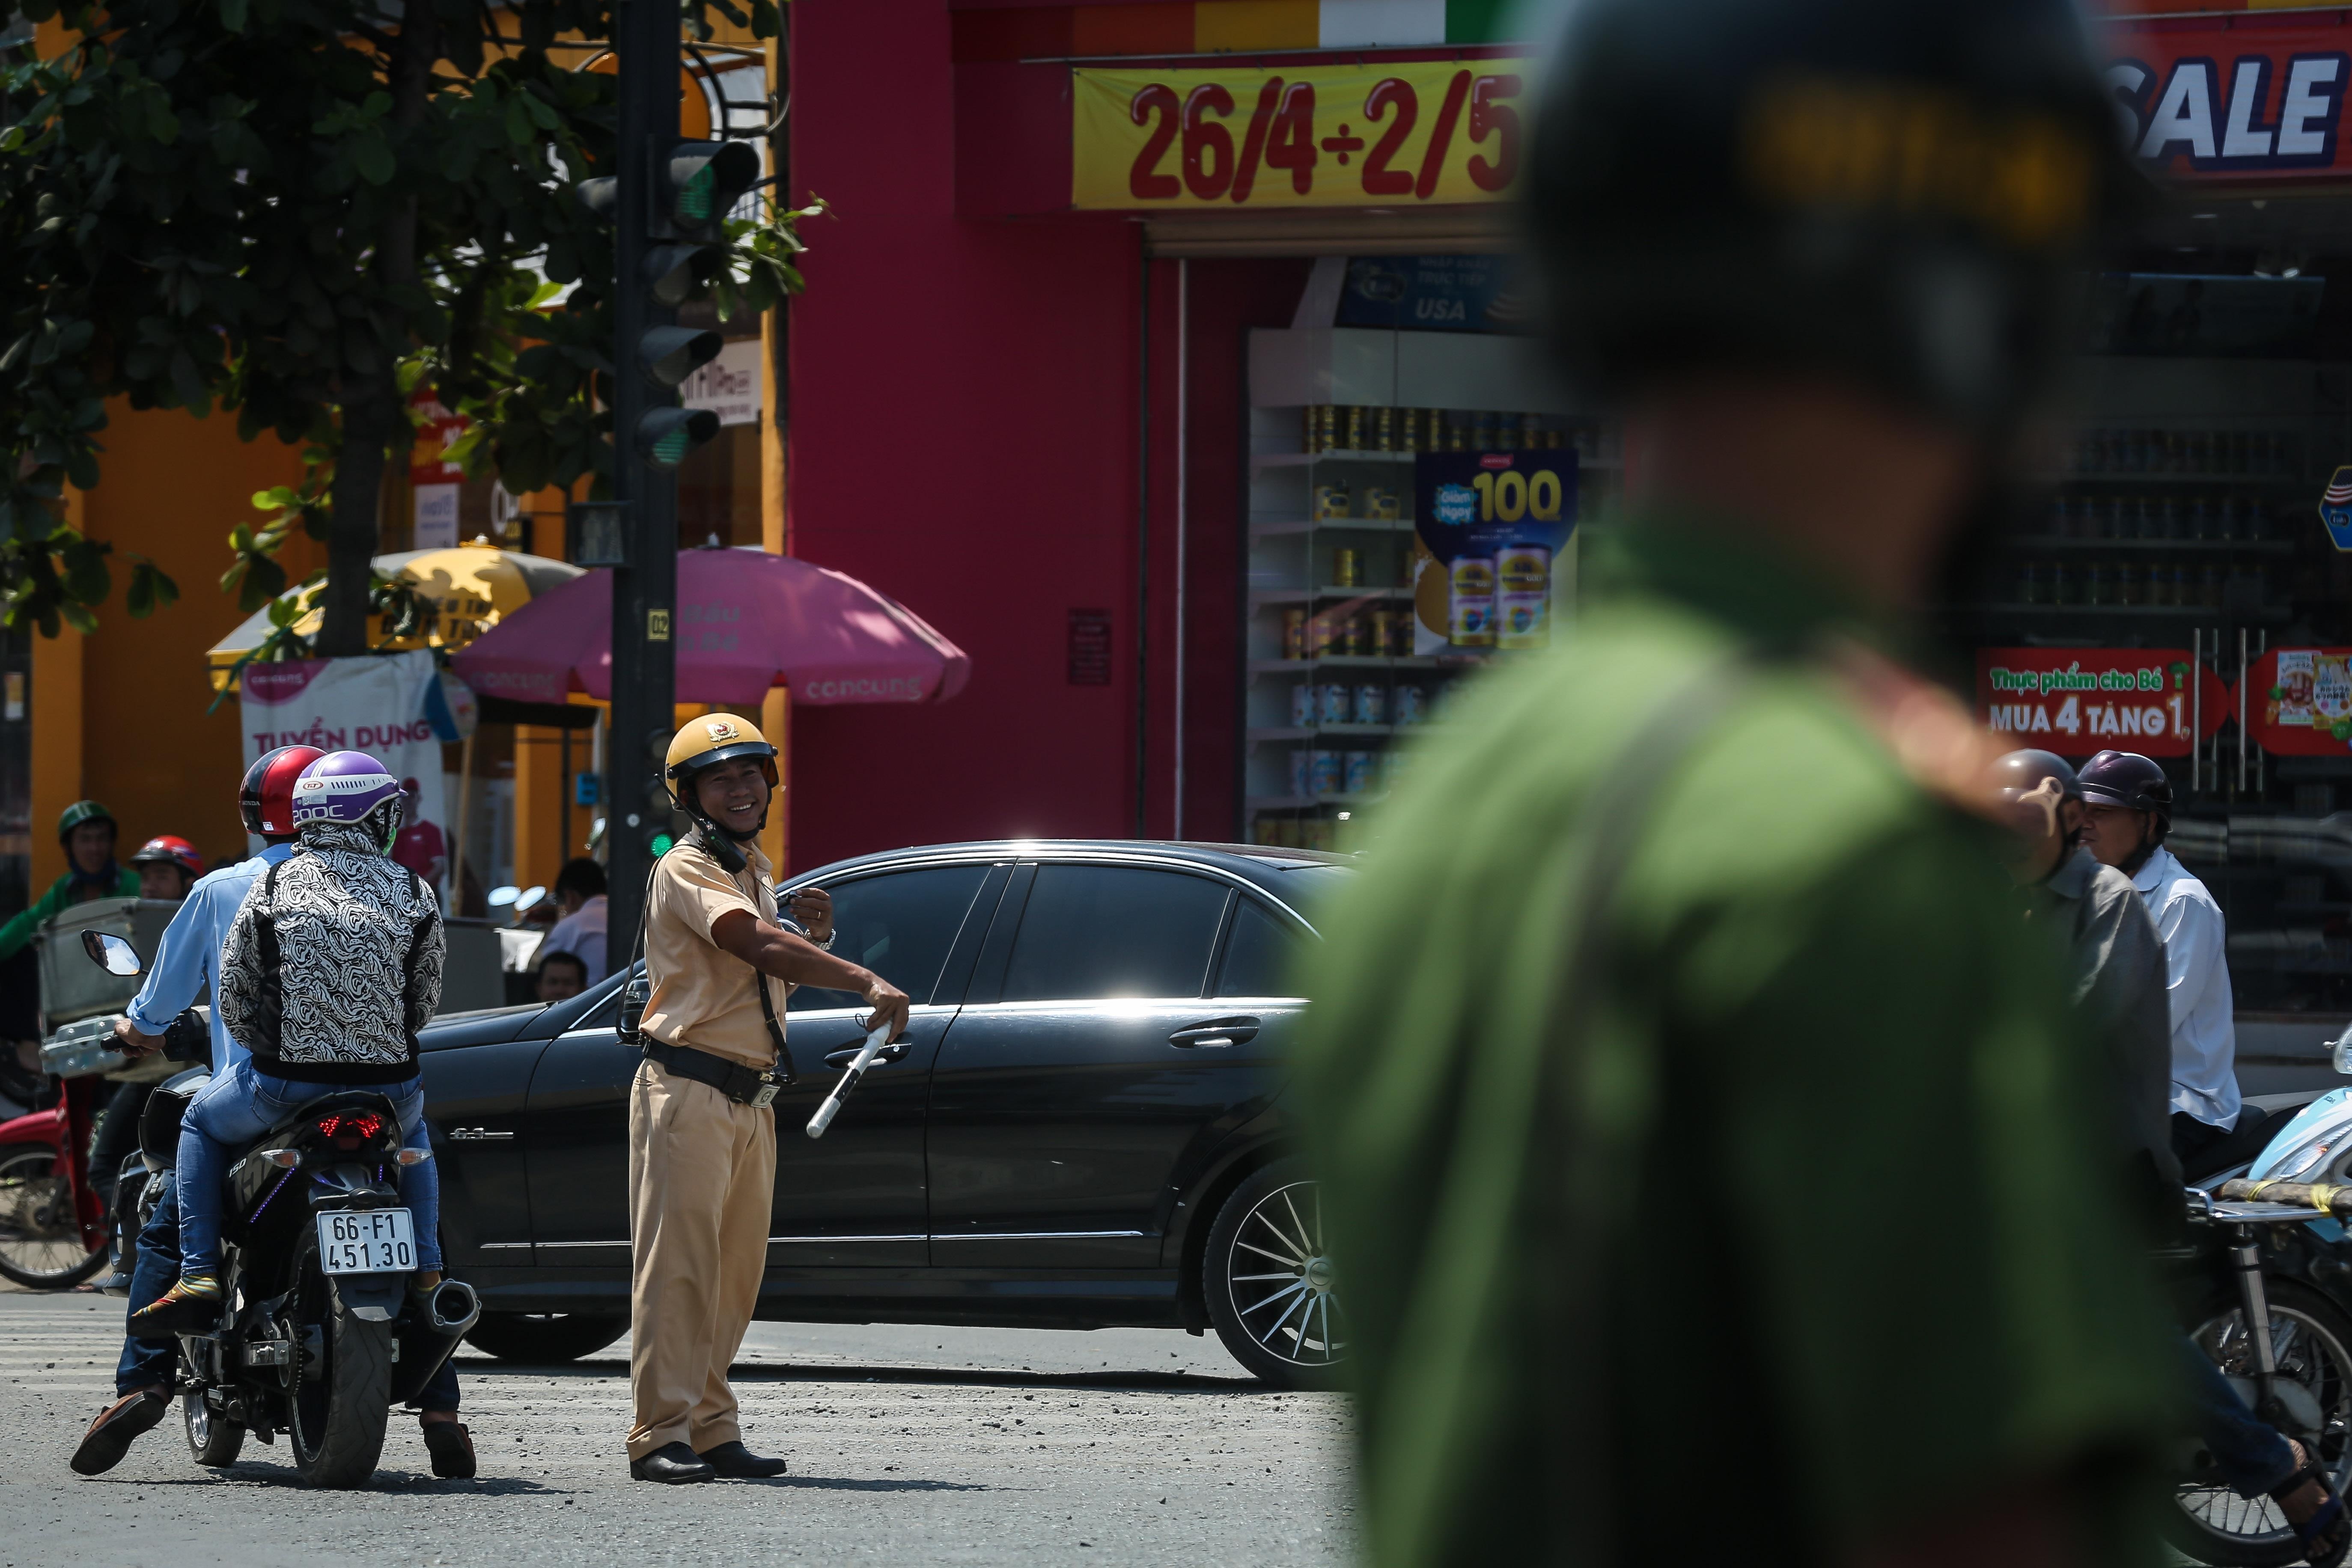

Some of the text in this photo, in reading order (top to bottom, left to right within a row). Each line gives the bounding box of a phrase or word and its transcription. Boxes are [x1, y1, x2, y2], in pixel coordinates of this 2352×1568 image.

[2100, 58, 2340, 158] SALE
[1415, 298, 1466, 320] USA
[1473, 469, 1562, 523] 100
[805, 676, 923, 702] concung
[1990, 661, 2163, 696] Thực phẩm cho Bé
[1989, 704, 2051, 733] MUA
[2055, 695, 2081, 736] 4
[2086, 700, 2166, 740] TẶNG
[355, 719, 432, 753] DỤNG
[229, 1157, 247, 1178] 150
[333, 1214, 395, 1241] 66-F1
[329, 1242, 410, 1269] 451.30
